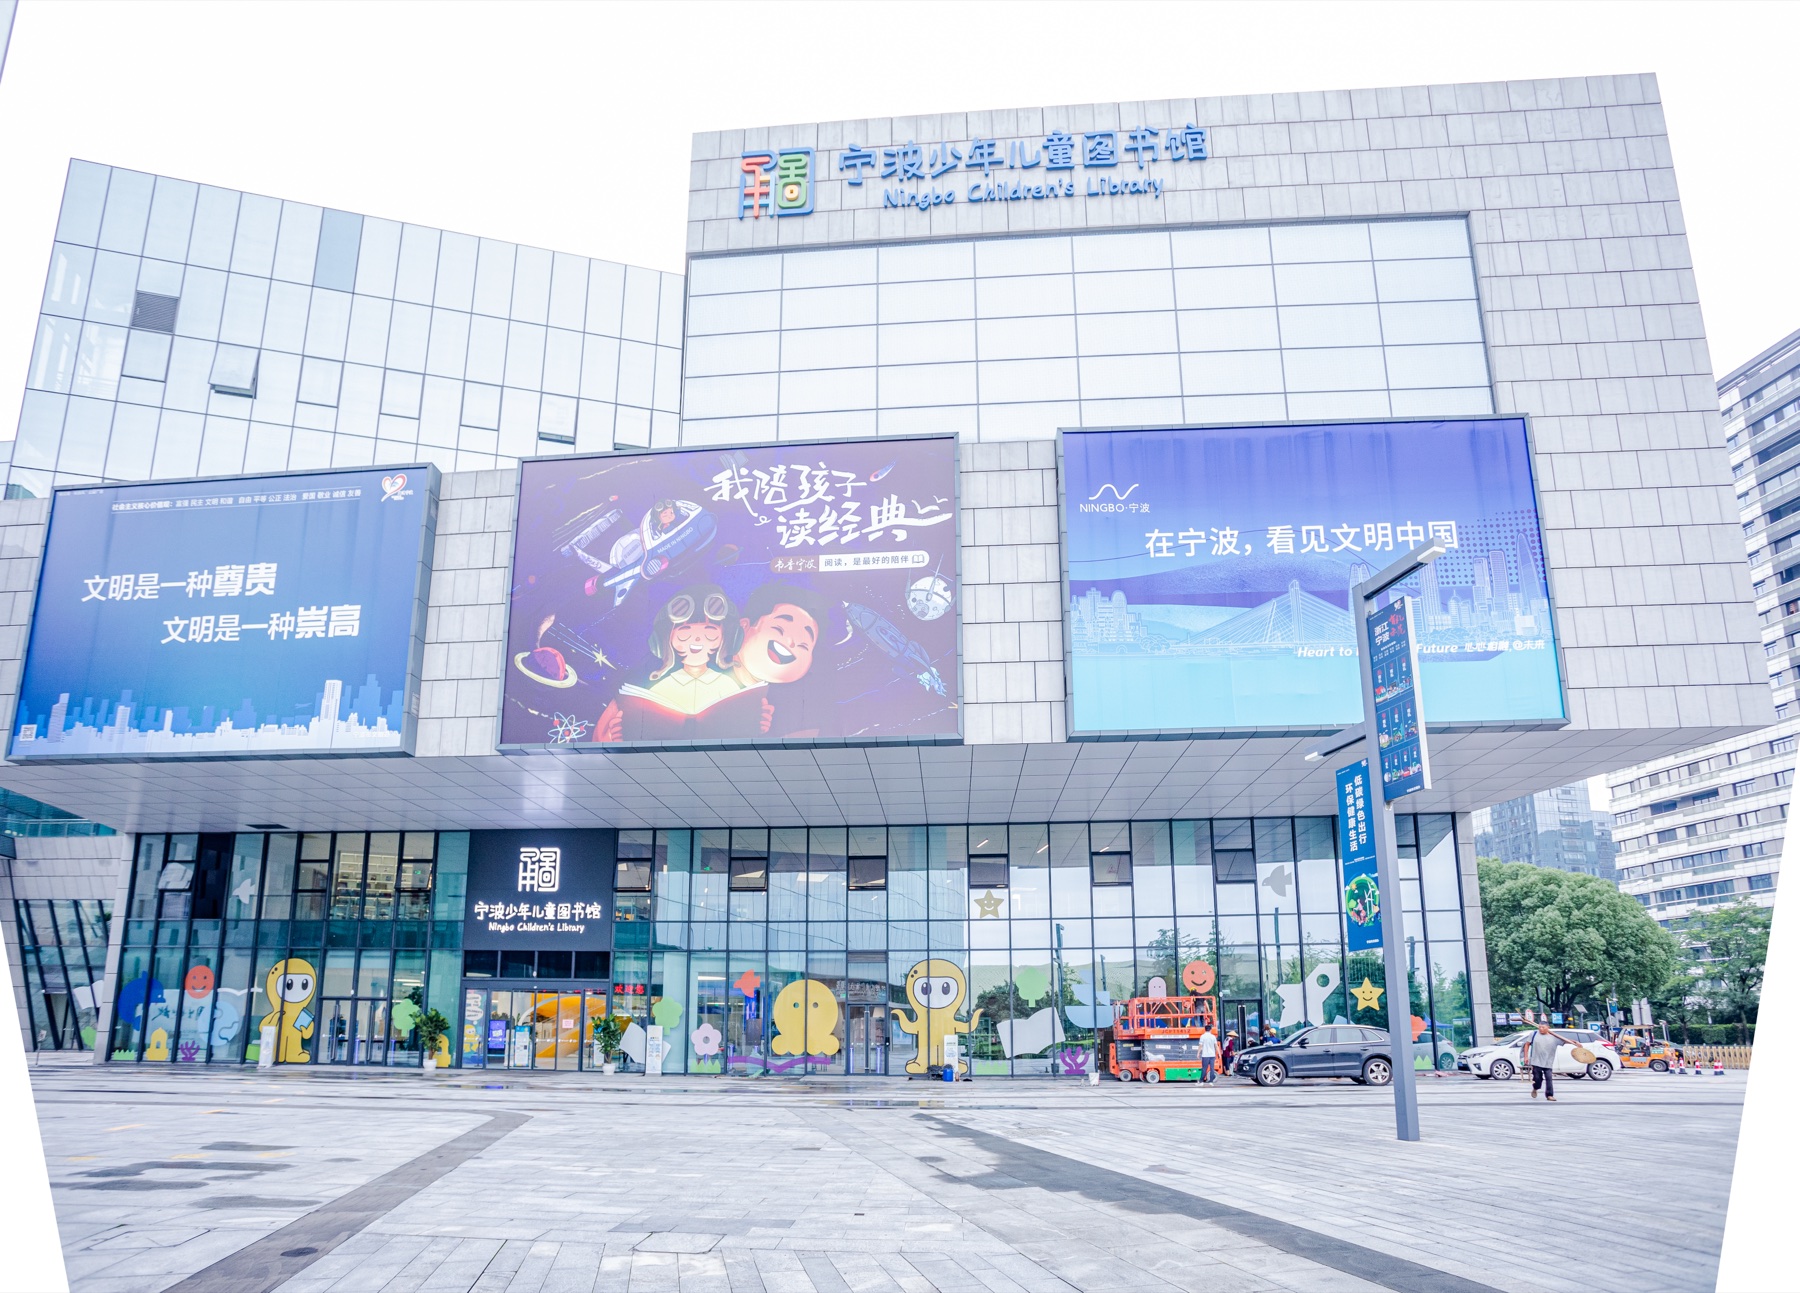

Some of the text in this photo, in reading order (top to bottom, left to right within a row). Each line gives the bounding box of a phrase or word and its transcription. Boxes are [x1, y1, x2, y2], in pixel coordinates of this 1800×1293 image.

[839, 122, 1208, 186] 宁波少年儿童图书馆
[883, 175, 1164, 211] Ningbo Children's Library
[704, 461, 867, 517] 我陪孩子
[1079, 502, 1151, 513] NINGBO·宁波
[776, 493, 953, 549] 读经典
[657, 543, 671, 553] MADE
[1145, 520, 1459, 558] 在宁波，看见文明中国
[774, 558, 817, 572] 书香宁波
[824, 555, 909, 567] 阅读，是最好的陪伴
[81, 562, 278, 602] 文明是一种尊贵
[161, 604, 361, 644] 文明是一种崇高
[1374, 621, 1389, 636] 浙江
[1375, 632, 1390, 646] 宁波
[1415, 643, 1458, 653] Future
[1297, 646, 1334, 657] Heart
[1339, 646, 1353, 657] to
[1345, 783, 1358, 852] 环保健康生活
[1354, 775, 1367, 845] 低碳绿色出行
[474, 900, 602, 921] 宁波少年儿童图书馆
[488, 922, 585, 934] Ningbo Children's Library
